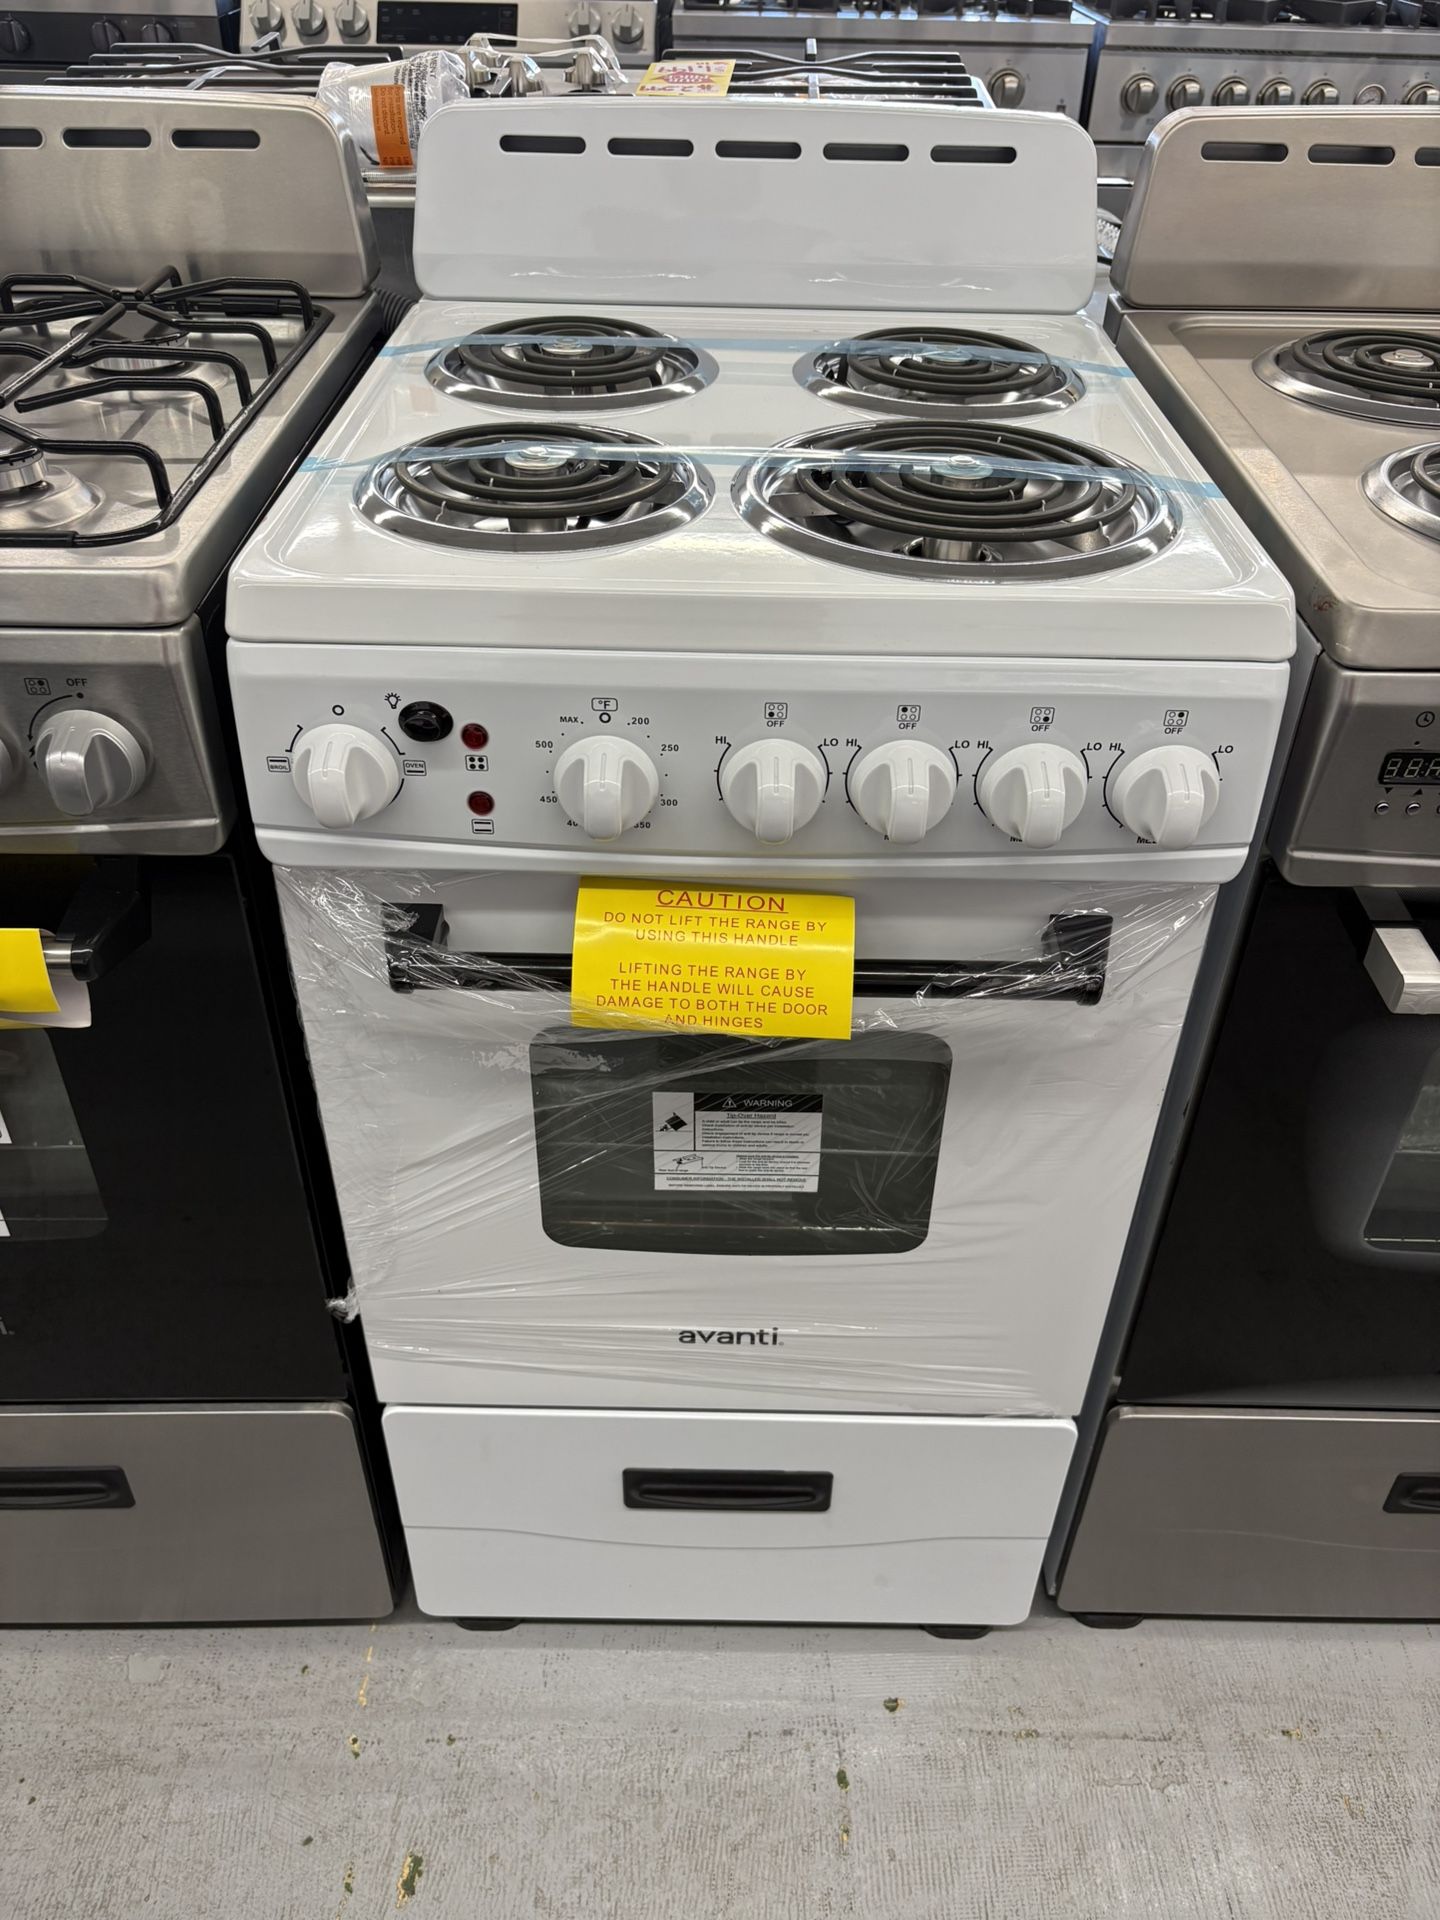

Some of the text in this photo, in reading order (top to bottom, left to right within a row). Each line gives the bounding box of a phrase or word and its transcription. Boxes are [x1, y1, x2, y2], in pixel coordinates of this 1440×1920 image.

[66, 678, 88, 687] OFF
[631, 717, 650, 725] 200
[766, 720, 785, 728] OFF
[1031, 724, 1050, 732] OFF
[1164, 727, 1183, 735] OFF
[715, 736, 727, 744] HI
[823, 738, 839, 747] LO
[846, 739, 858, 747] HI
[954, 740, 970, 749] LO
[661, 744, 679, 752] 250
[977, 741, 989, 749] HI
[1086, 742, 1102, 751] LO
[1109, 742, 1121, 751] HI
[1218, 745, 1234, 754] LO
[656, 889, 786, 912] CAUTION
[604, 911, 827, 932] DO NOT LIFT THE RANGE BY
[635, 929, 798, 946] USING THIS HANDLE
[619, 962, 807, 981] LIFTING THE RANGE BY
[610, 979, 814, 998] THE HANDLE WILL CAUSE
[596, 995, 827, 1016] DAMAGE TO BOTH THE DOOR
[664, 1014, 763, 1029] AND HINGES
[743, 1099, 793, 1107] WARNING
[678, 1327, 779, 1345] avanti
